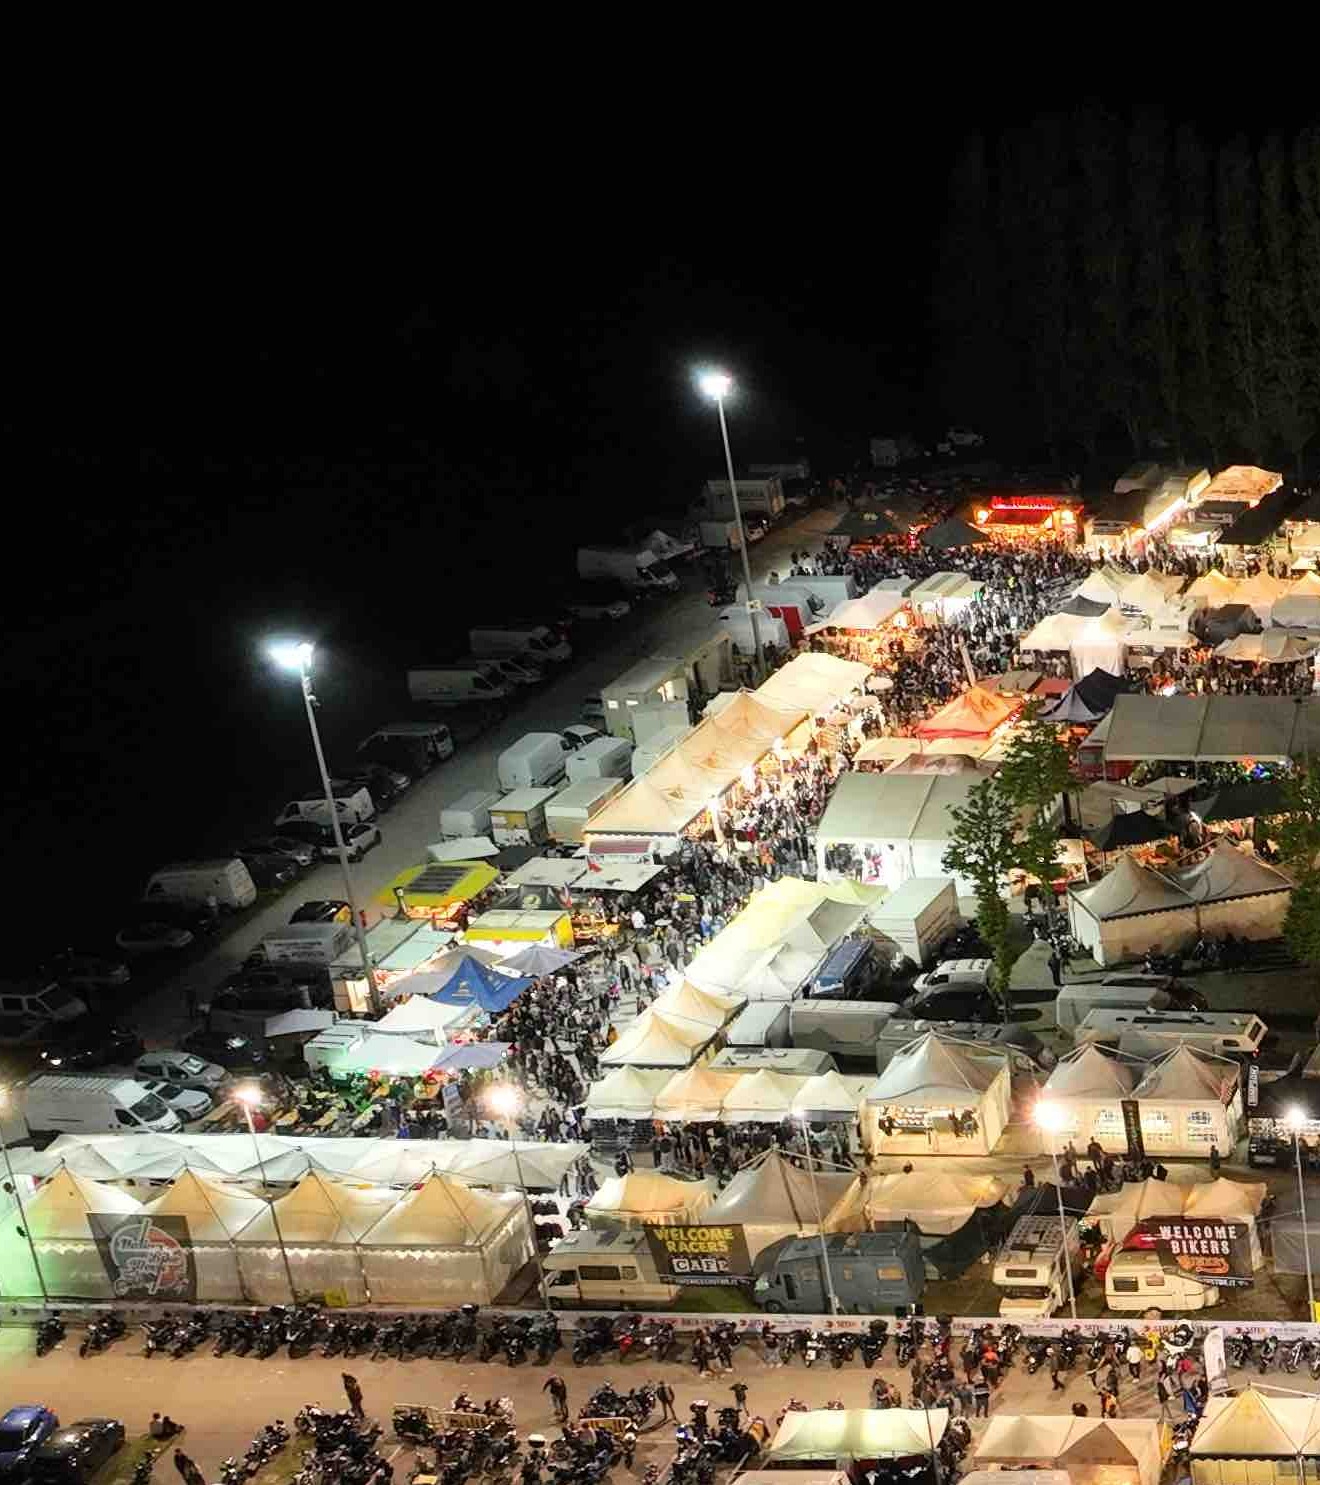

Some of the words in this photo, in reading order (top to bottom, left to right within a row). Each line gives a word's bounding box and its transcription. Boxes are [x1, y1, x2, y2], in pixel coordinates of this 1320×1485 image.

[653, 1227, 734, 1240] WELCOME
[1159, 1225, 1237, 1239] WELCOME
[666, 1241, 728, 1253] RACERS
[1170, 1240, 1230, 1254] BIKERS
